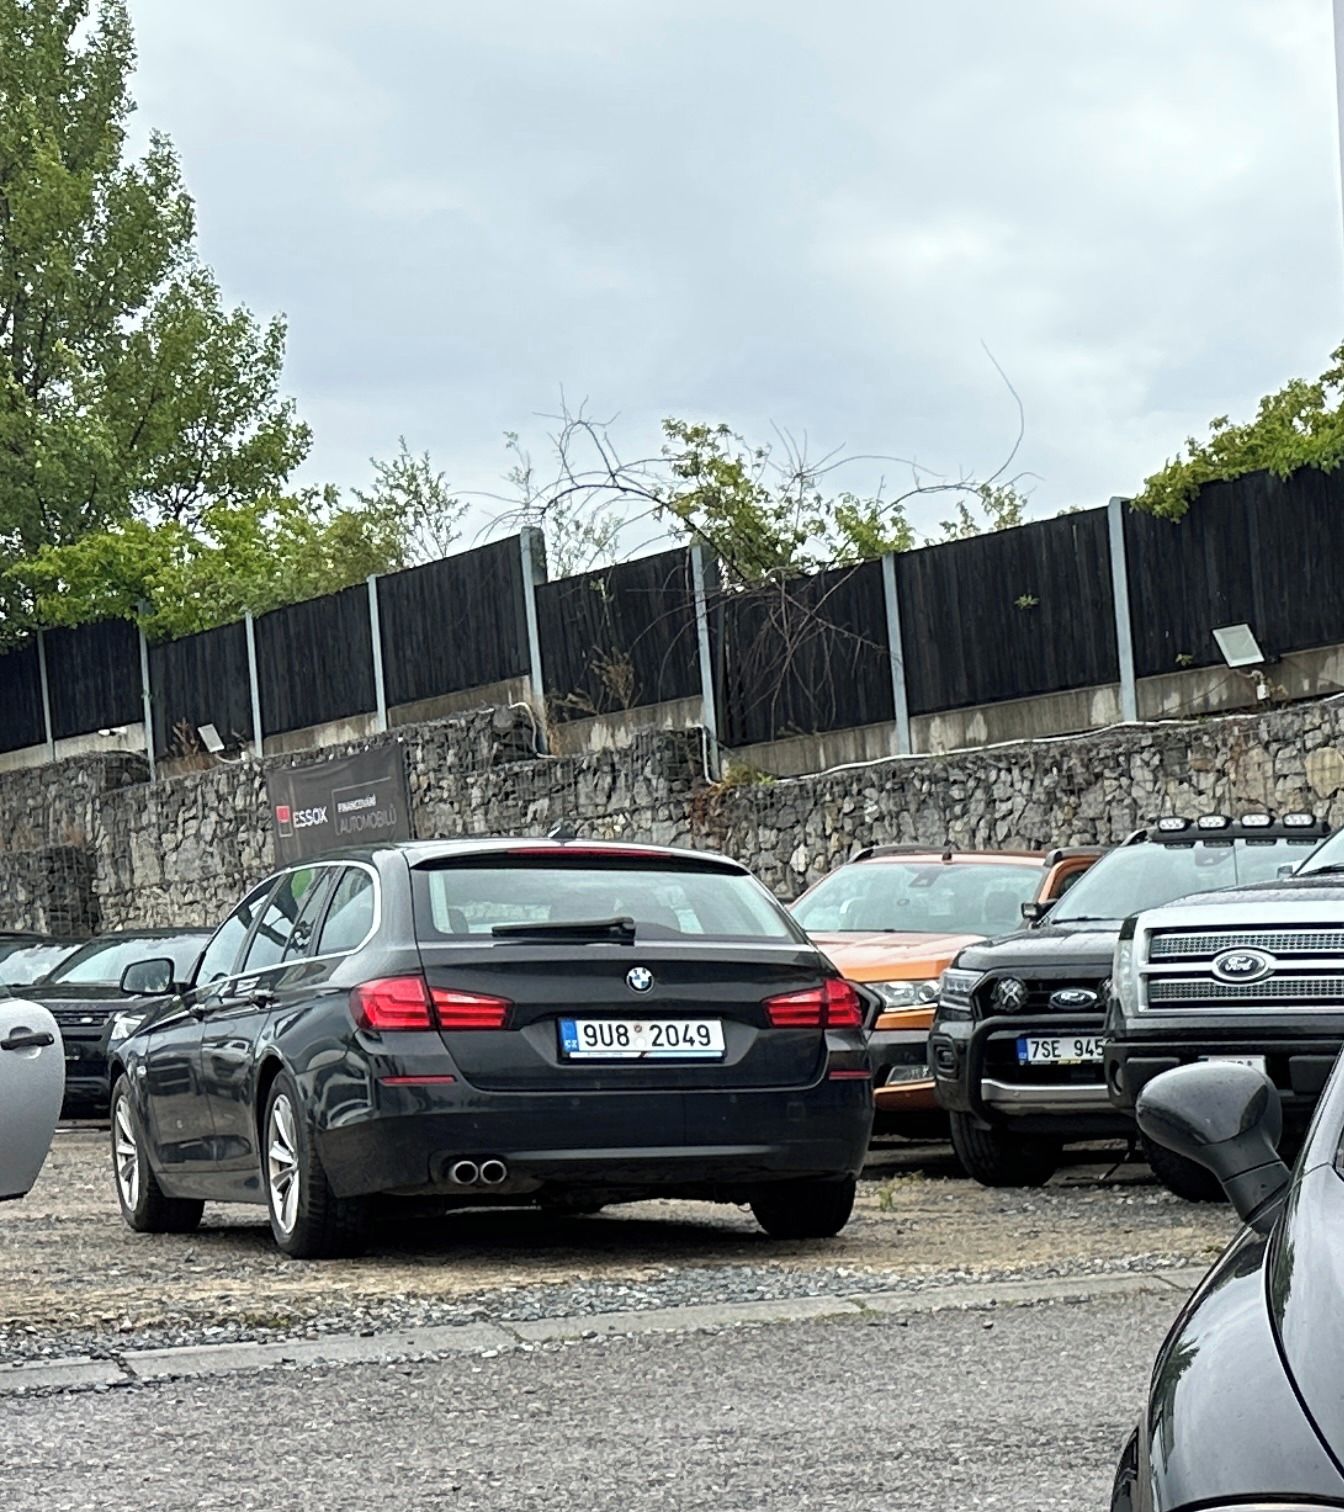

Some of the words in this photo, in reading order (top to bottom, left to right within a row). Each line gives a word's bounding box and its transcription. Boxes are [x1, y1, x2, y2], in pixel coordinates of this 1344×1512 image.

[292, 806, 329, 828] ESSOX
[583, 1023, 630, 1047] 9U8
[648, 1023, 712, 1047] 2049
[1030, 1039, 1061, 1058] 7SE
